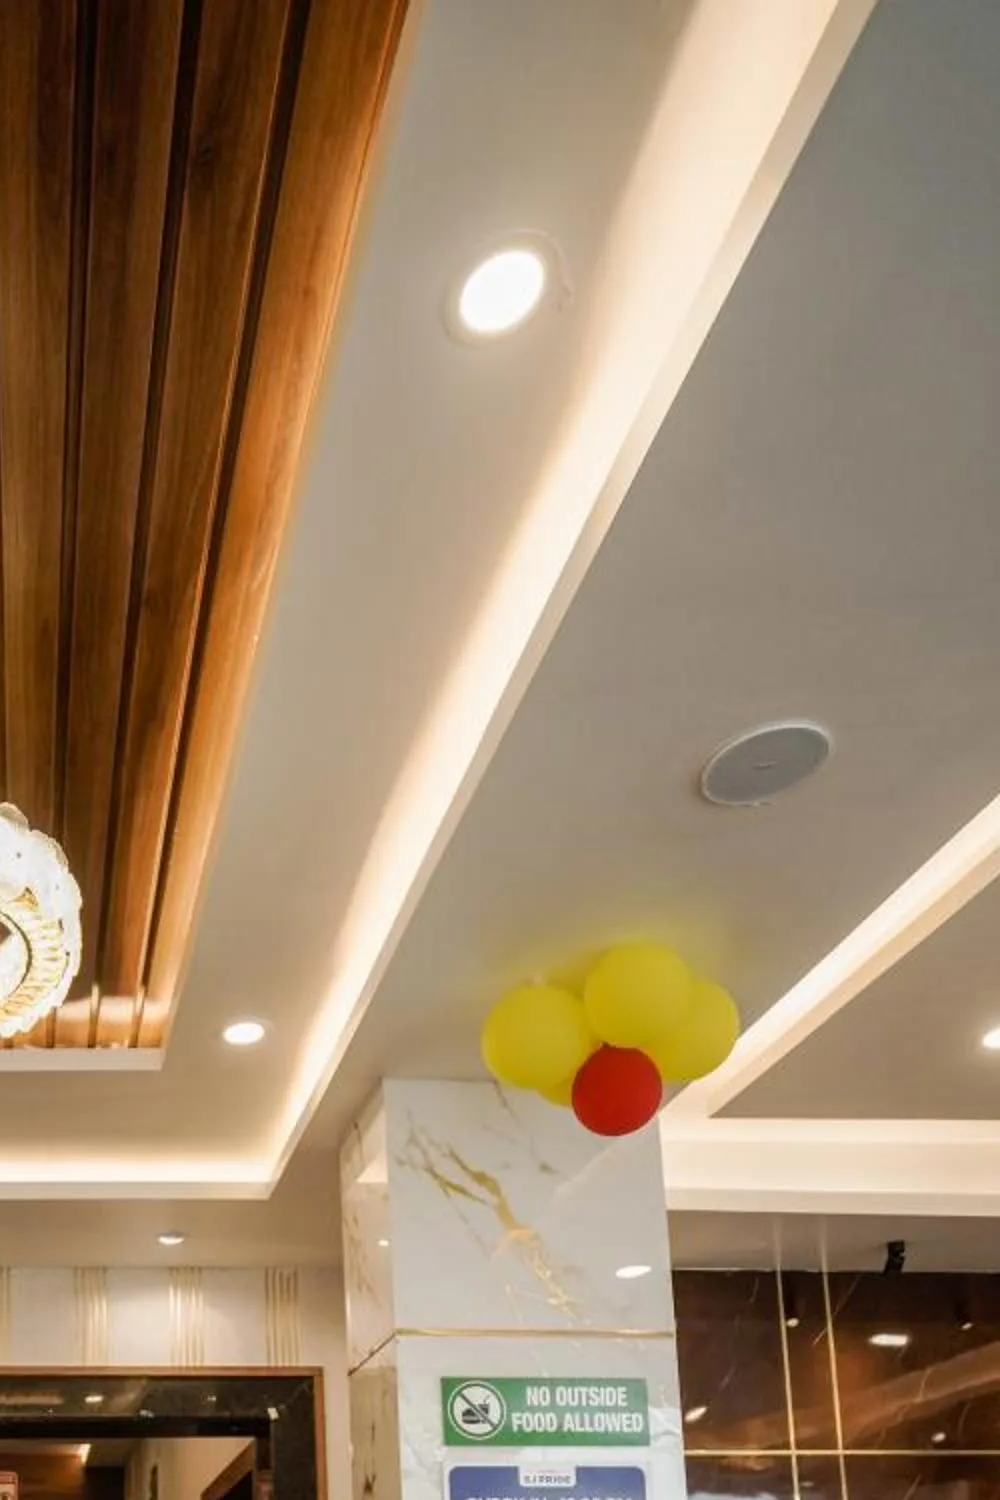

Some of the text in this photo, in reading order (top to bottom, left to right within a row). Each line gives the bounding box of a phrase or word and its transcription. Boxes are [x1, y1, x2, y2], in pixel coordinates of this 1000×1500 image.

[525, 1386, 628, 1407] NO OUTSIDE
[511, 1412, 644, 1433] FOOD ALLOWED
